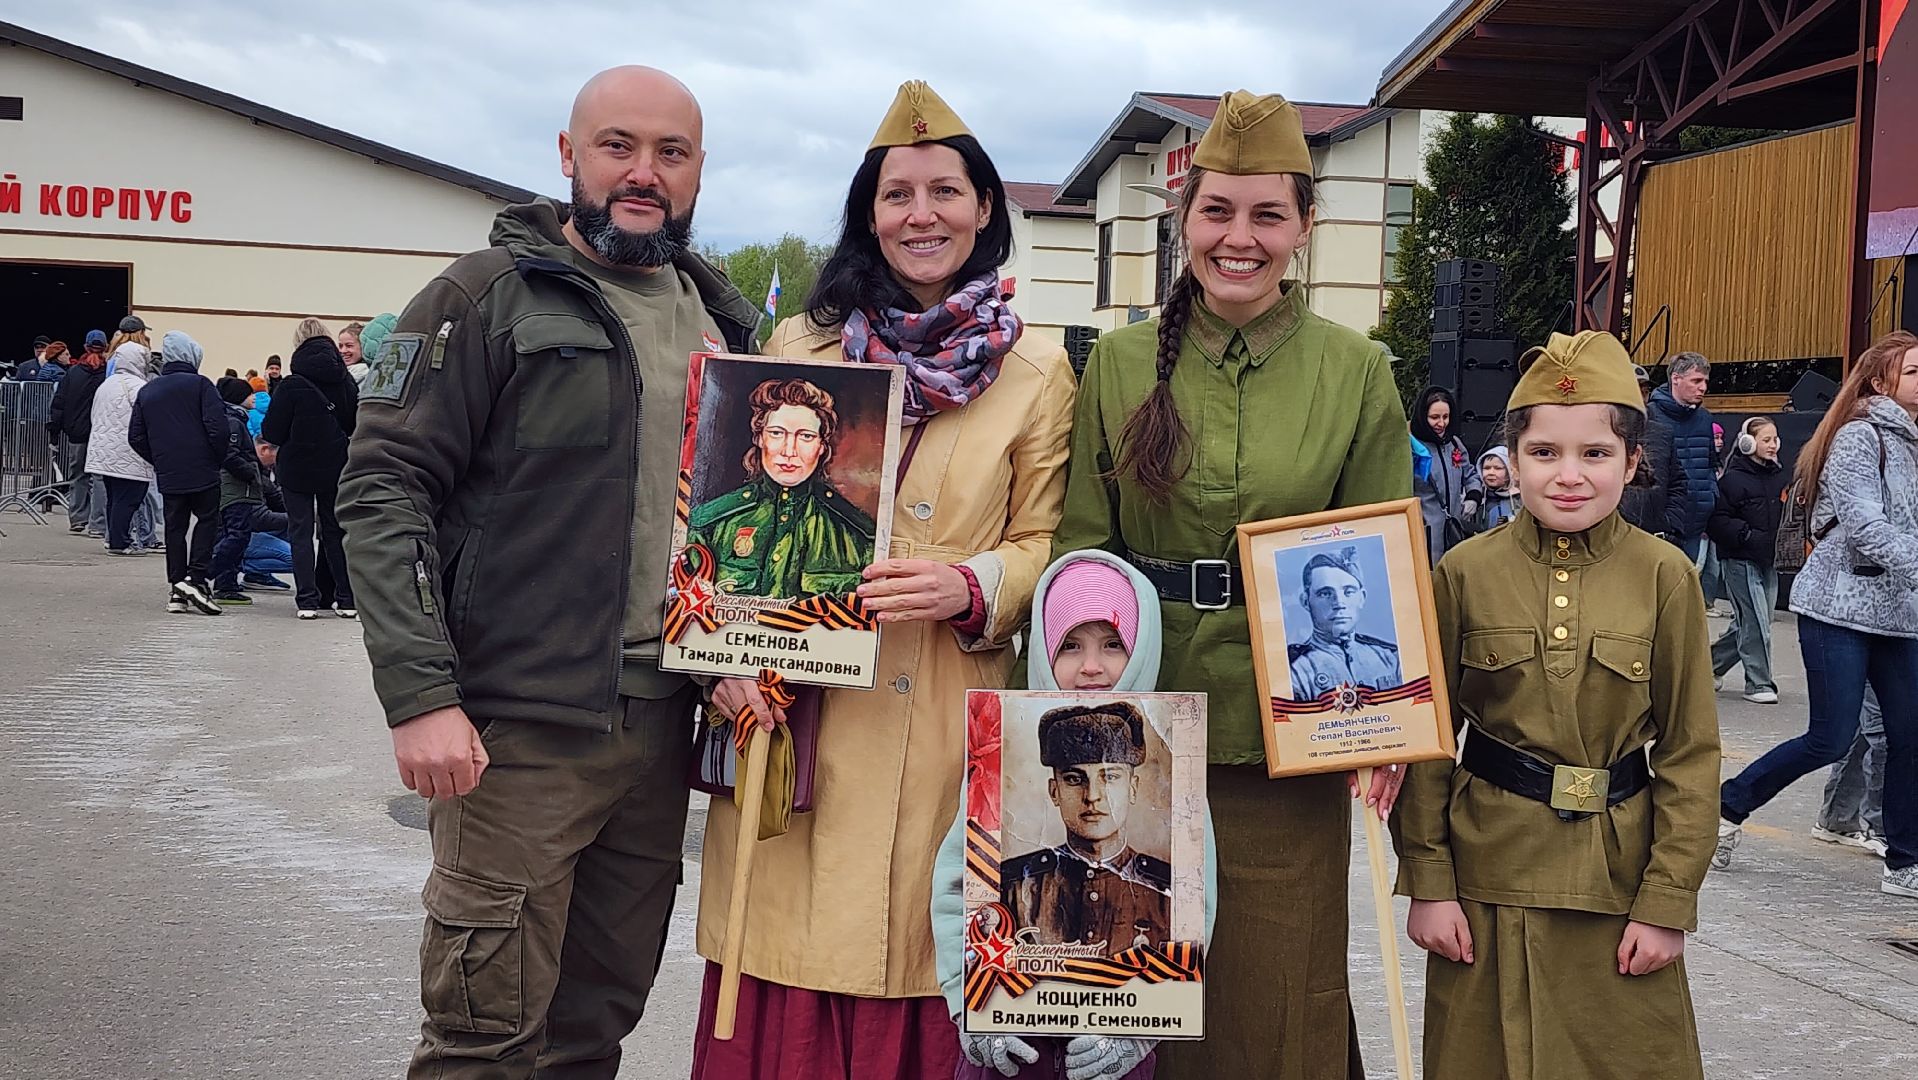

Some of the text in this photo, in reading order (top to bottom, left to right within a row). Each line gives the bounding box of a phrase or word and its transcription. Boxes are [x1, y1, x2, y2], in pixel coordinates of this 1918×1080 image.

[40, 184, 192, 223] КОРПУС
[713, 608, 759, 624] ПОЛК
[725, 631, 810, 652] СЕМЁНОВА
[678, 646, 861, 676] Тамара Александровна
[1317, 714, 1391, 731] ДЕМЬЯНЧЕНКО
[1310, 725, 1402, 742] Степан Васильевич
[1017, 958, 1068, 973] ПОЛК
[1036, 990, 1138, 1008] КОЩИЕНКО
[992, 1010, 1182, 1029] Владимир Семенович
